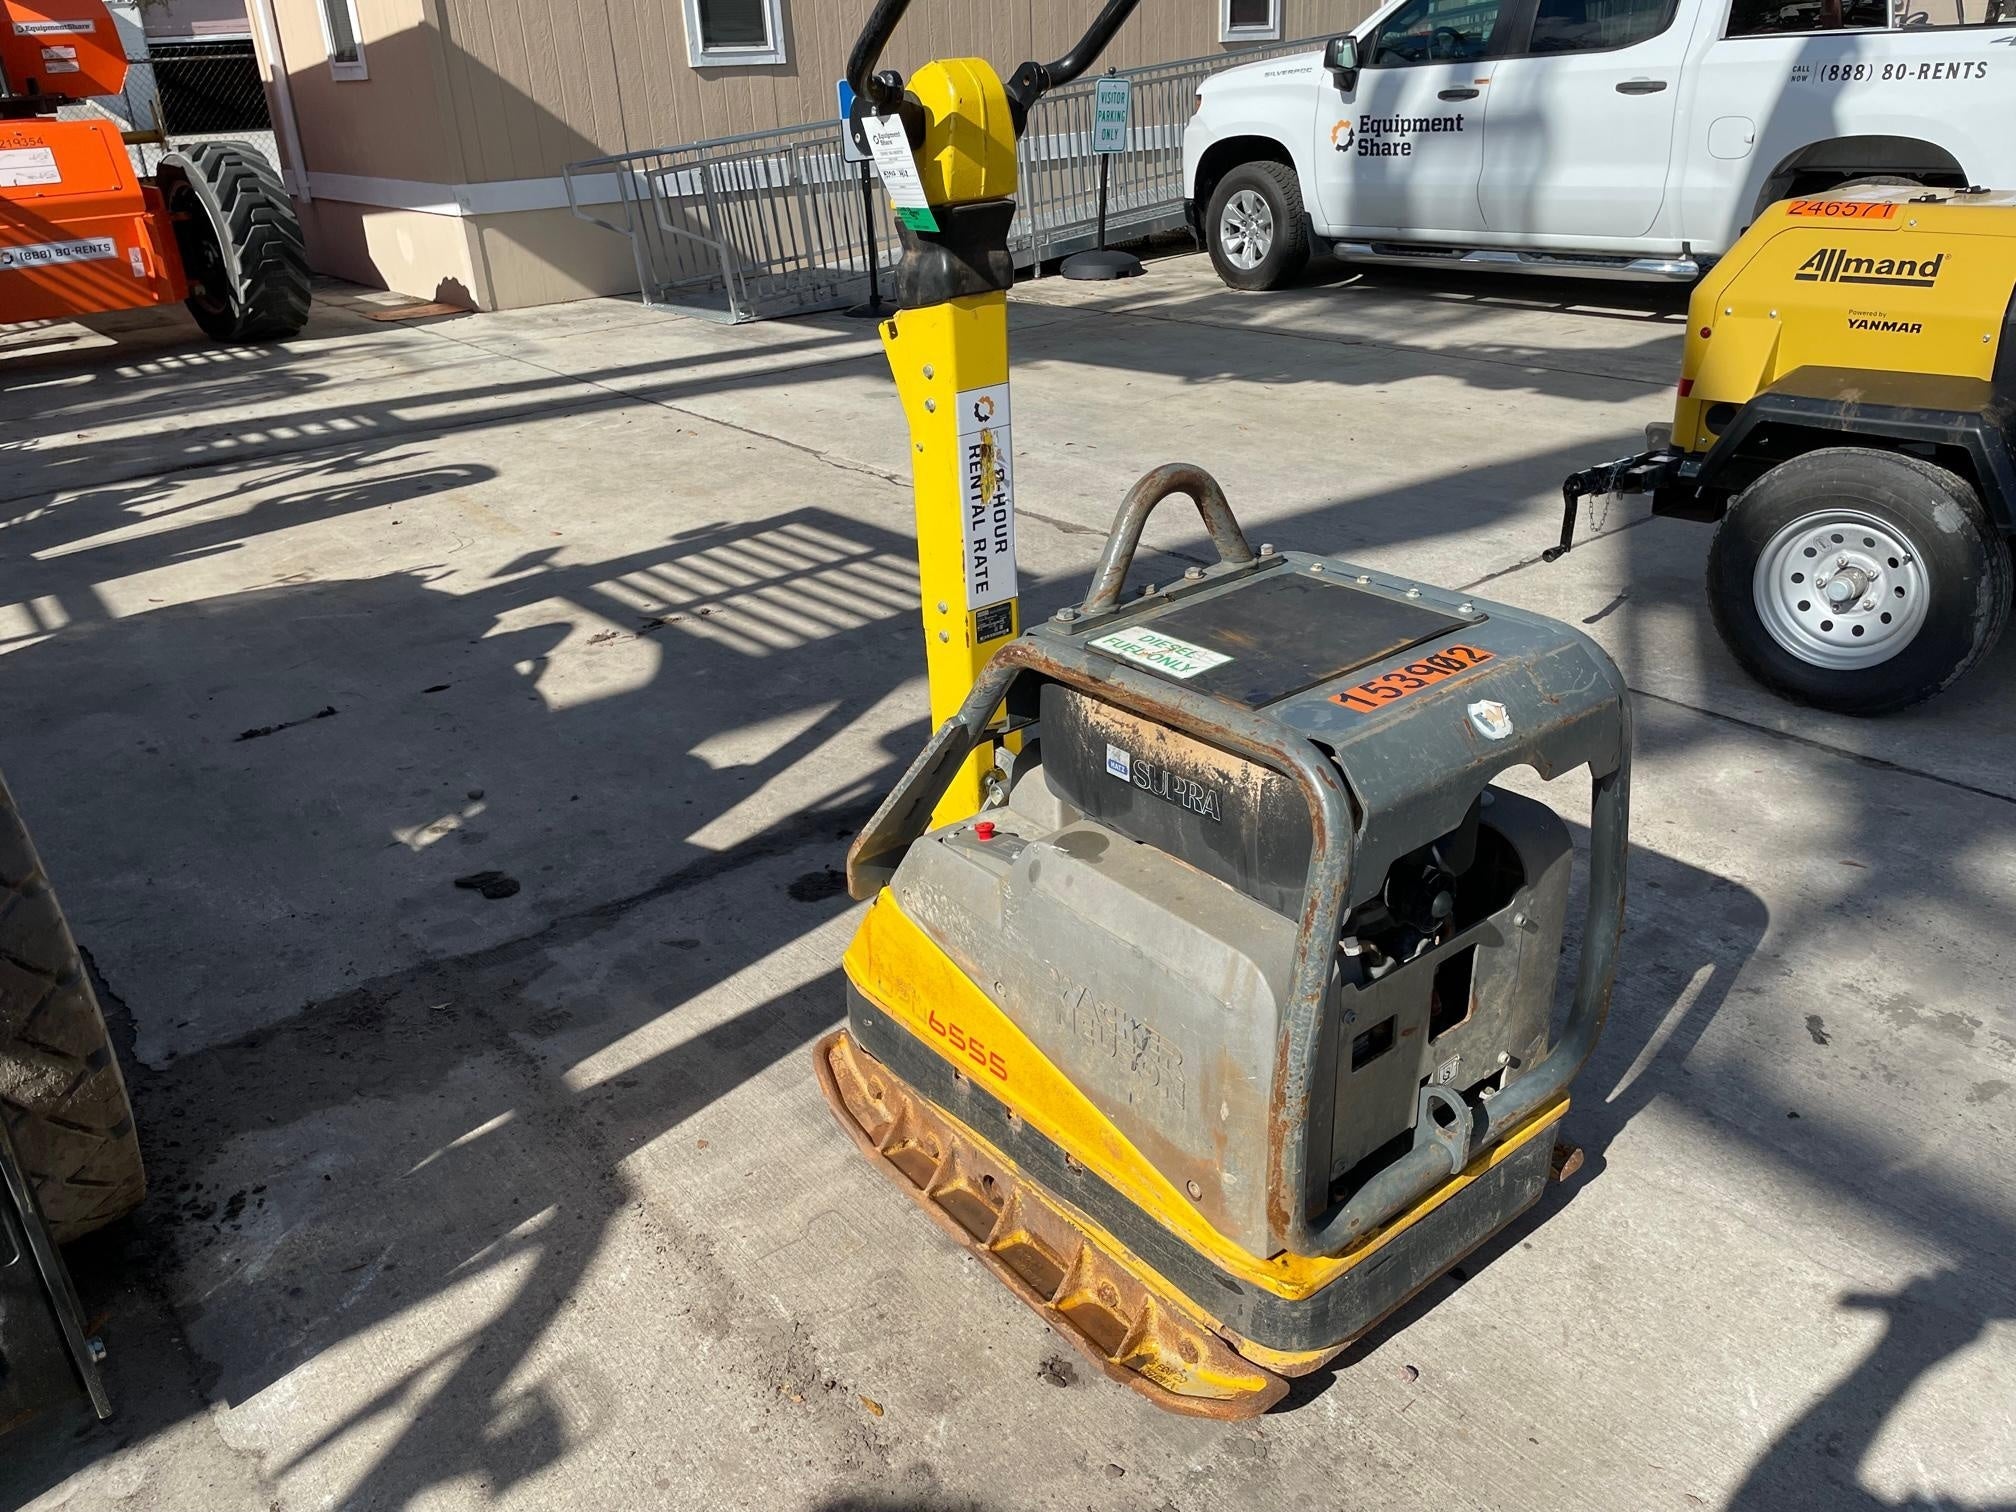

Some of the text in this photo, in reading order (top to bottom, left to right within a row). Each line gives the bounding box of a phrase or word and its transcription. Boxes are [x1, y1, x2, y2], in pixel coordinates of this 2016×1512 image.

[25, 23, 90, 33] EquipmentShare
[1791, 74, 1808, 82] NOW
[1792, 65, 1810, 73] CALL
[1820, 61, 1988, 82] (888) 80-RENTS
[1101, 92, 1125, 104] VISITOR
[1097, 110, 1125, 122] PARKING
[1358, 113, 1464, 138] Equipment
[1102, 128, 1119, 141] ONLY
[1357, 138, 1412, 157] Share
[1788, 201, 1894, 217] 246571
[19, 243, 111, 262] (888) 80-RENTS
[1797, 248, 1945, 283] Allmand
[1848, 308, 1888, 318] Powered by
[1848, 318, 1923, 334] YANMAR
[968, 443, 990, 595] RENTAL RATE
[1103, 637, 1200, 673] FUEL ONLY
[1138, 634, 1199, 659] DIESEL
[1132, 759, 1221, 822] SUPRA
[928, 1009, 1008, 1082] 6555
